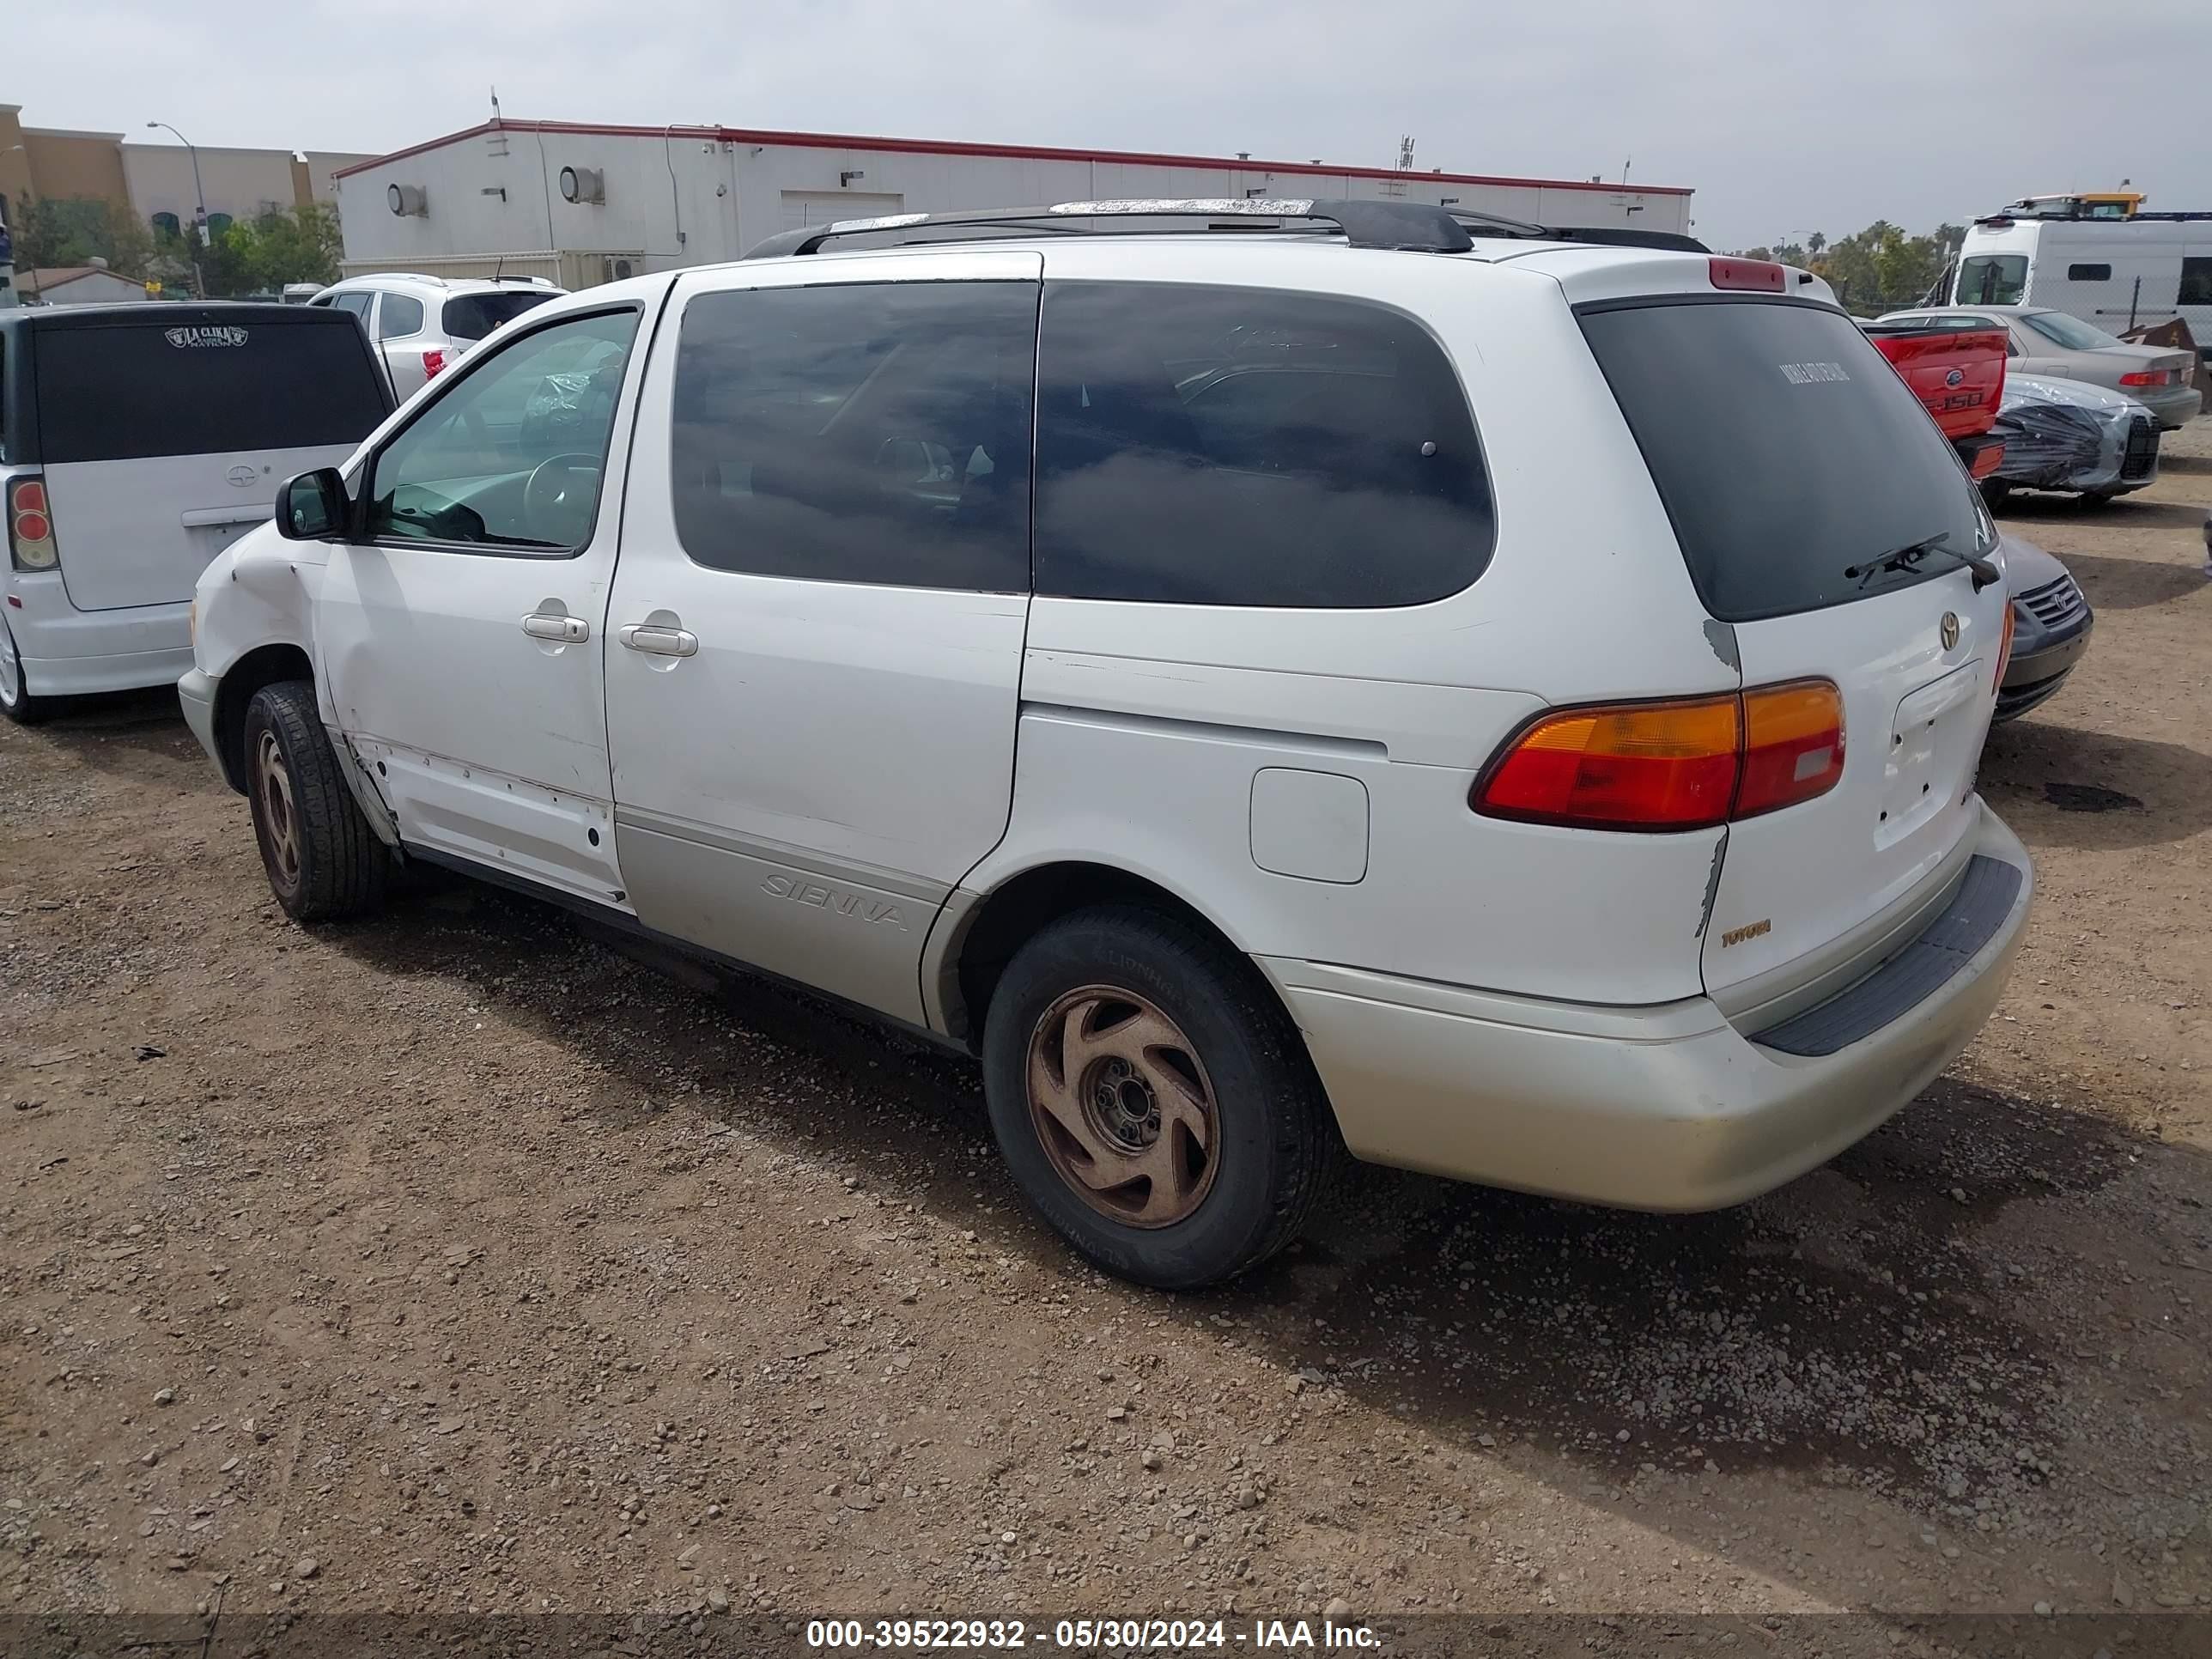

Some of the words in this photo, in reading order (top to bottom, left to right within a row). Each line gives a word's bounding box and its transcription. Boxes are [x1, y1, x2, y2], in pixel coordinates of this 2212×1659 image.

[183, 328, 200, 344] LA
[201, 327, 232, 343] CLIKA
[760, 874, 908, 932] SIENNA
[1722, 919, 1771, 948] TOYOTA
